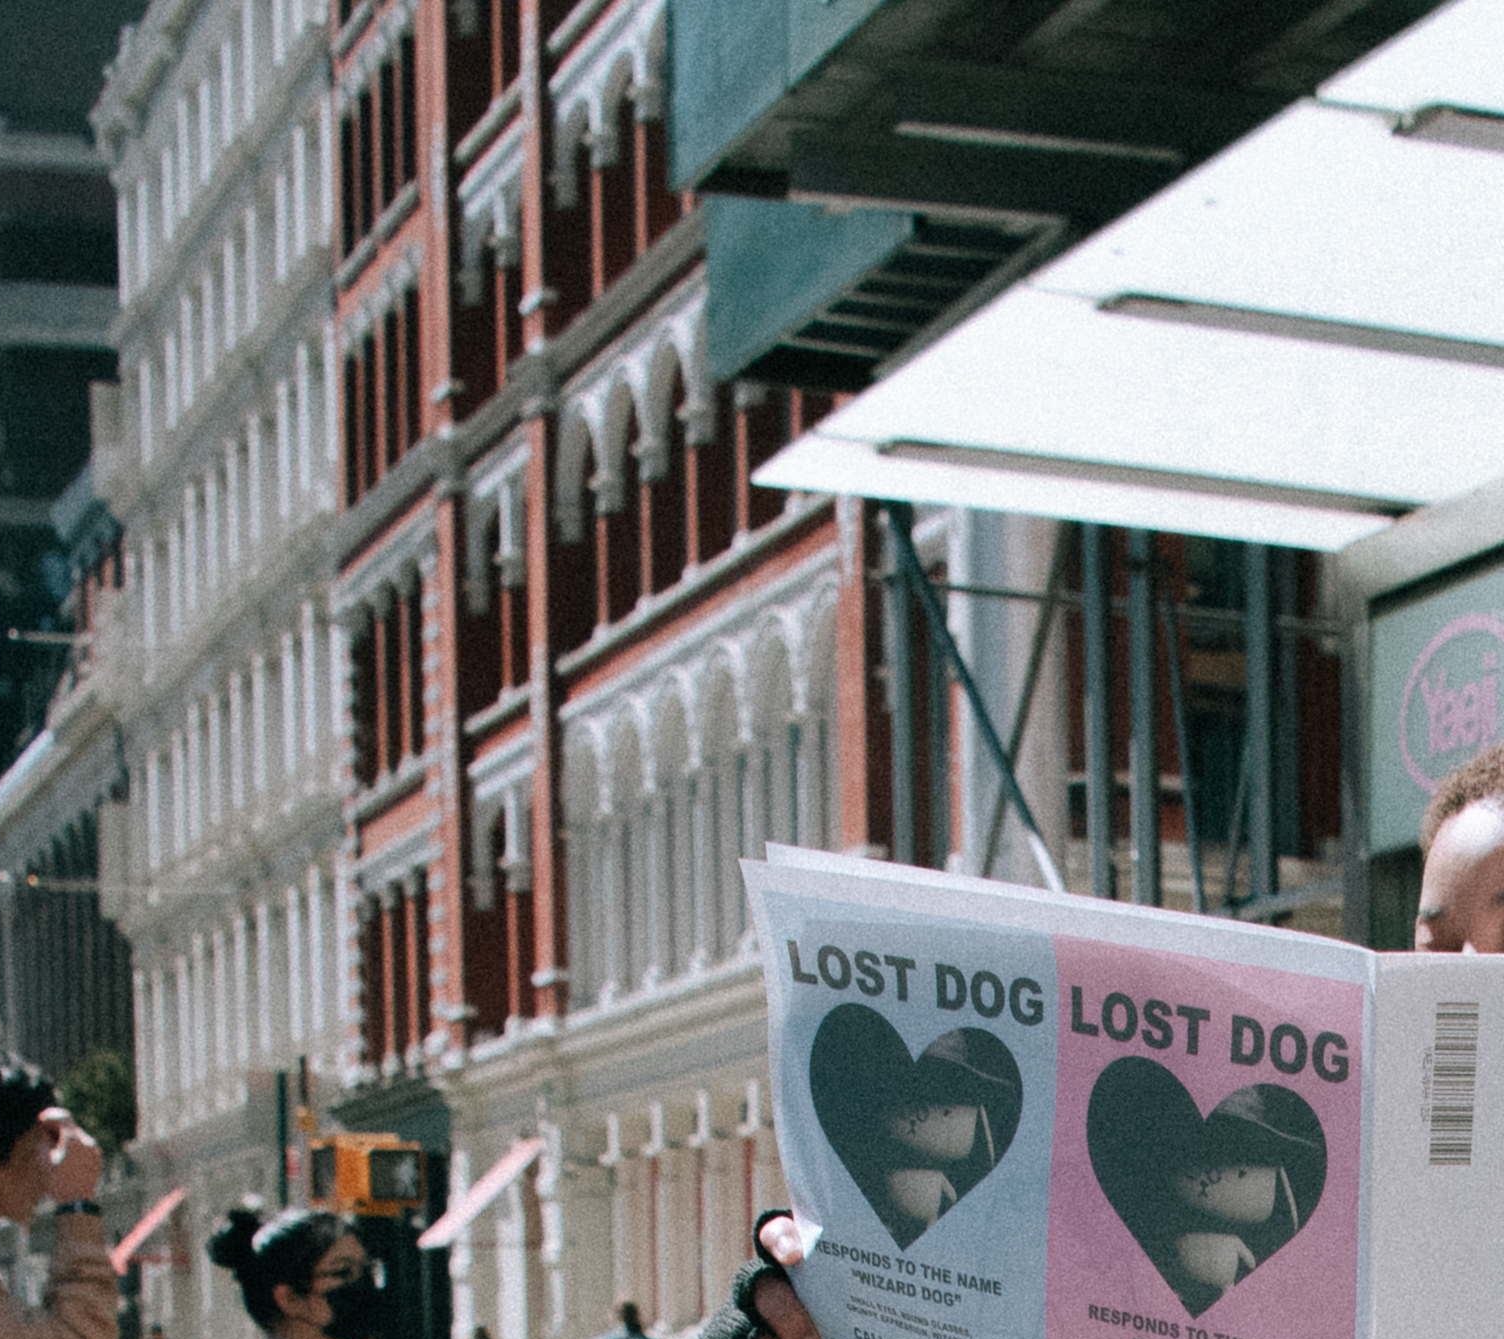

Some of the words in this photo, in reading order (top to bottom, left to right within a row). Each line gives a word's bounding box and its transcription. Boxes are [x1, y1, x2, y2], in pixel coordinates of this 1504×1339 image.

[786, 940, 916, 1003] LOST
[935, 964, 1045, 1027] DOG
[1071, 985, 1210, 1056] LOST
[1231, 1014, 1350, 1084] DOG
[896, 1259, 916, 1276] TO
[921, 1264, 952, 1283] THE
[957, 1273, 1002, 1295] NAME
[1089, 1305, 1180, 1339] RESPONDS
